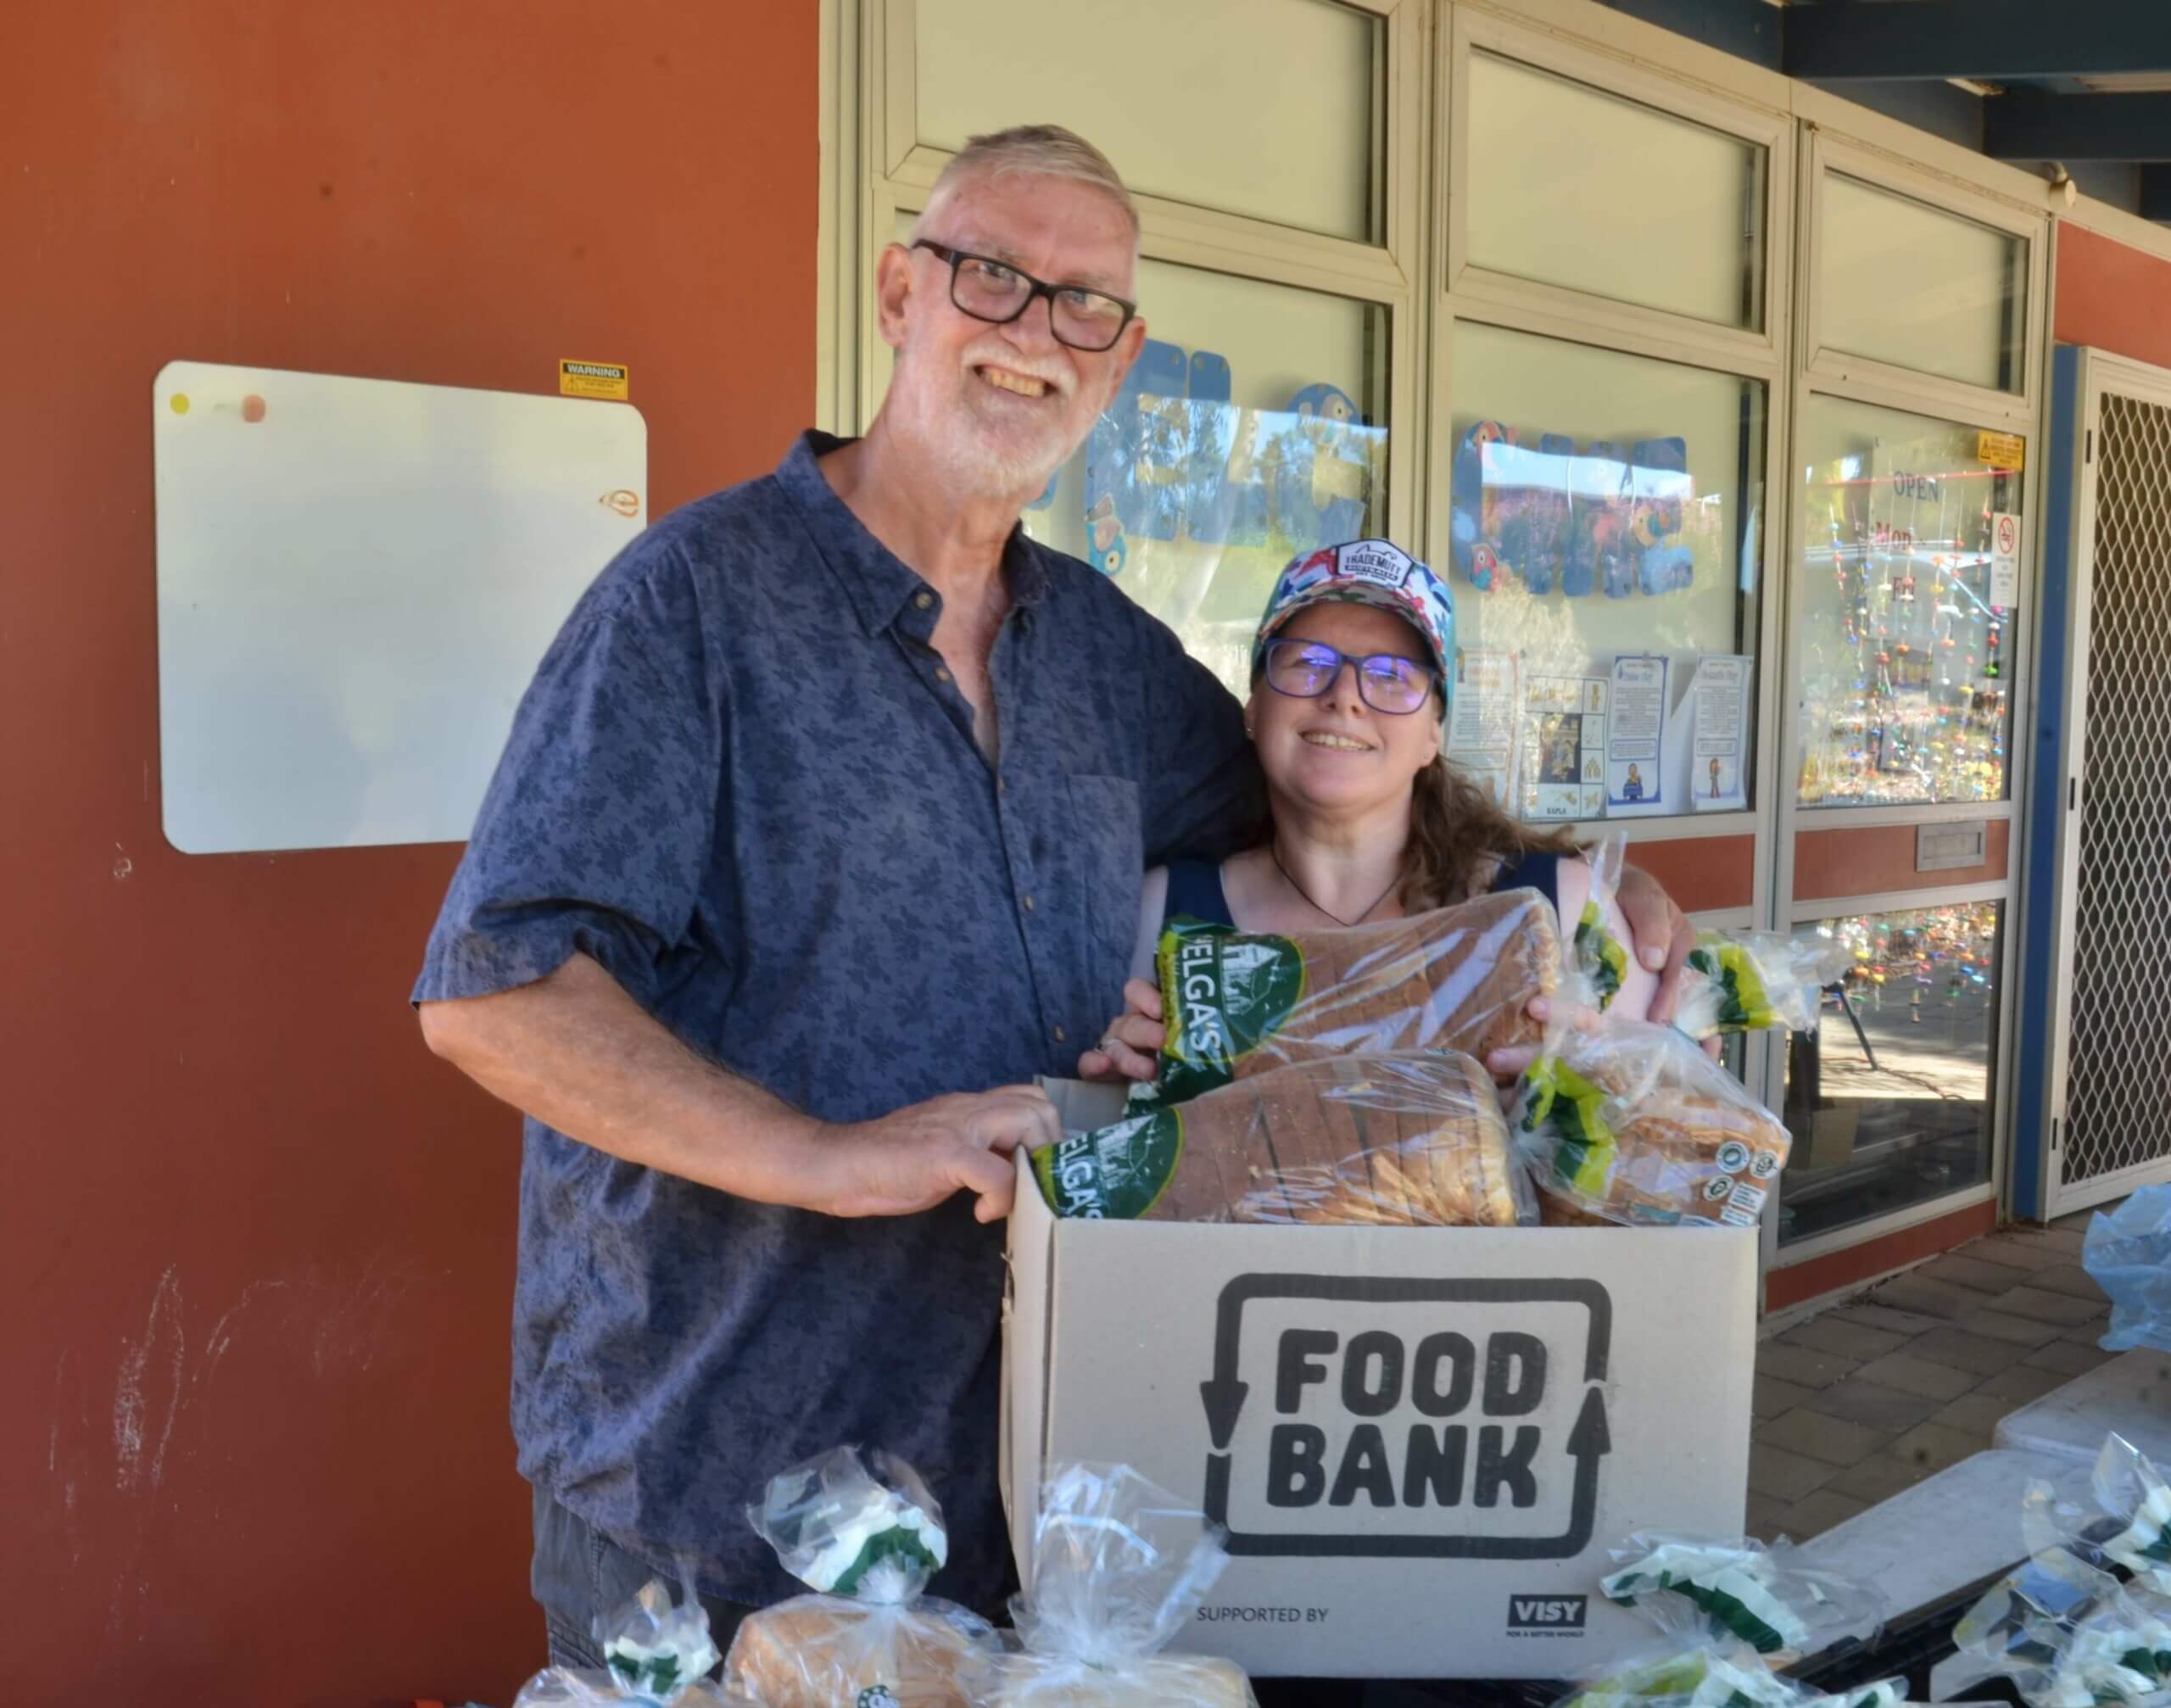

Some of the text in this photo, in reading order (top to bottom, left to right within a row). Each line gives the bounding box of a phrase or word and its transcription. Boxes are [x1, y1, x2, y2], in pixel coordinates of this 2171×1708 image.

[566, 364, 621, 378] WARNING
[1893, 471, 1939, 502] OPEN
[1345, 554, 1402, 574] TRADEMUTT
[1275, 1328, 1548, 1417] FOOD
[1266, 1423, 1541, 1508] BANK
[1196, 1606, 1330, 1622] SUPPORTED BY
[1515, 1601, 1582, 1622] VISY
